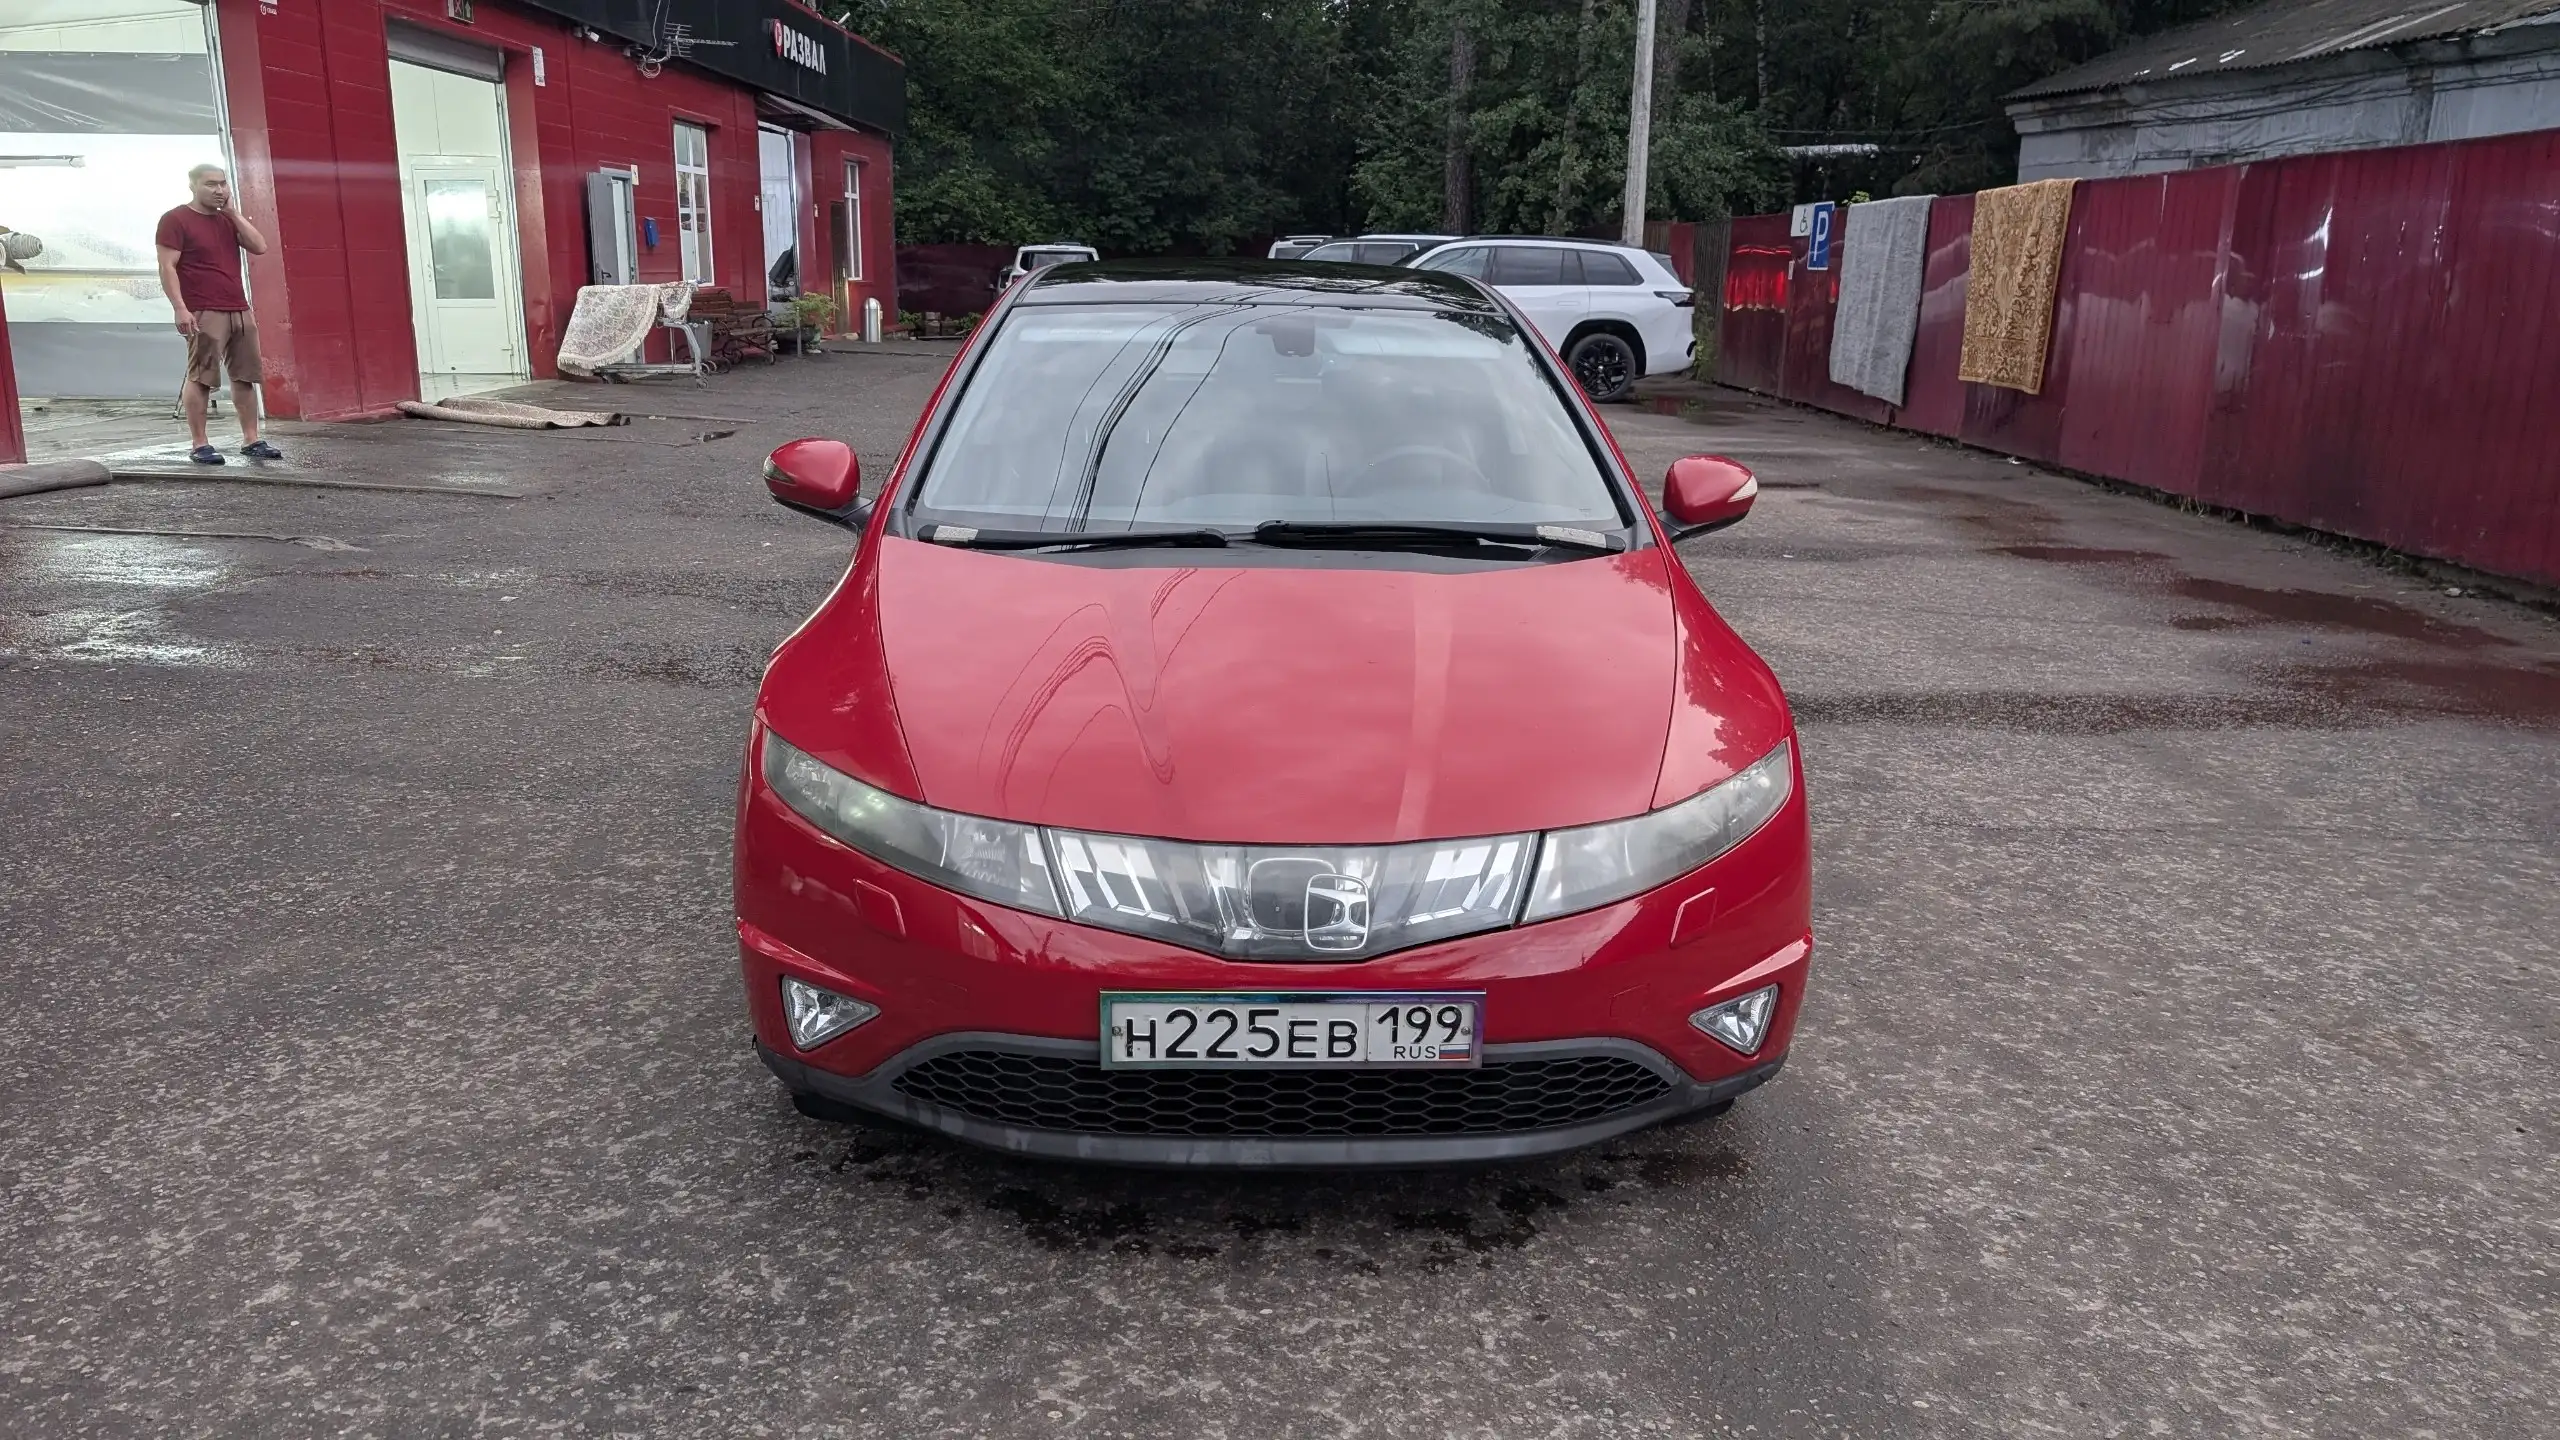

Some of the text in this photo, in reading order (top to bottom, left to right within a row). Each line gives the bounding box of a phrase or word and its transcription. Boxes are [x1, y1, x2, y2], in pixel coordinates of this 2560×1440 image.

[783, 24, 827, 76] РАЗВАЛ
[1813, 210, 1829, 262] P
[1377, 1004, 1463, 1044] 199
[1393, 1045, 1437, 1060] RUS
